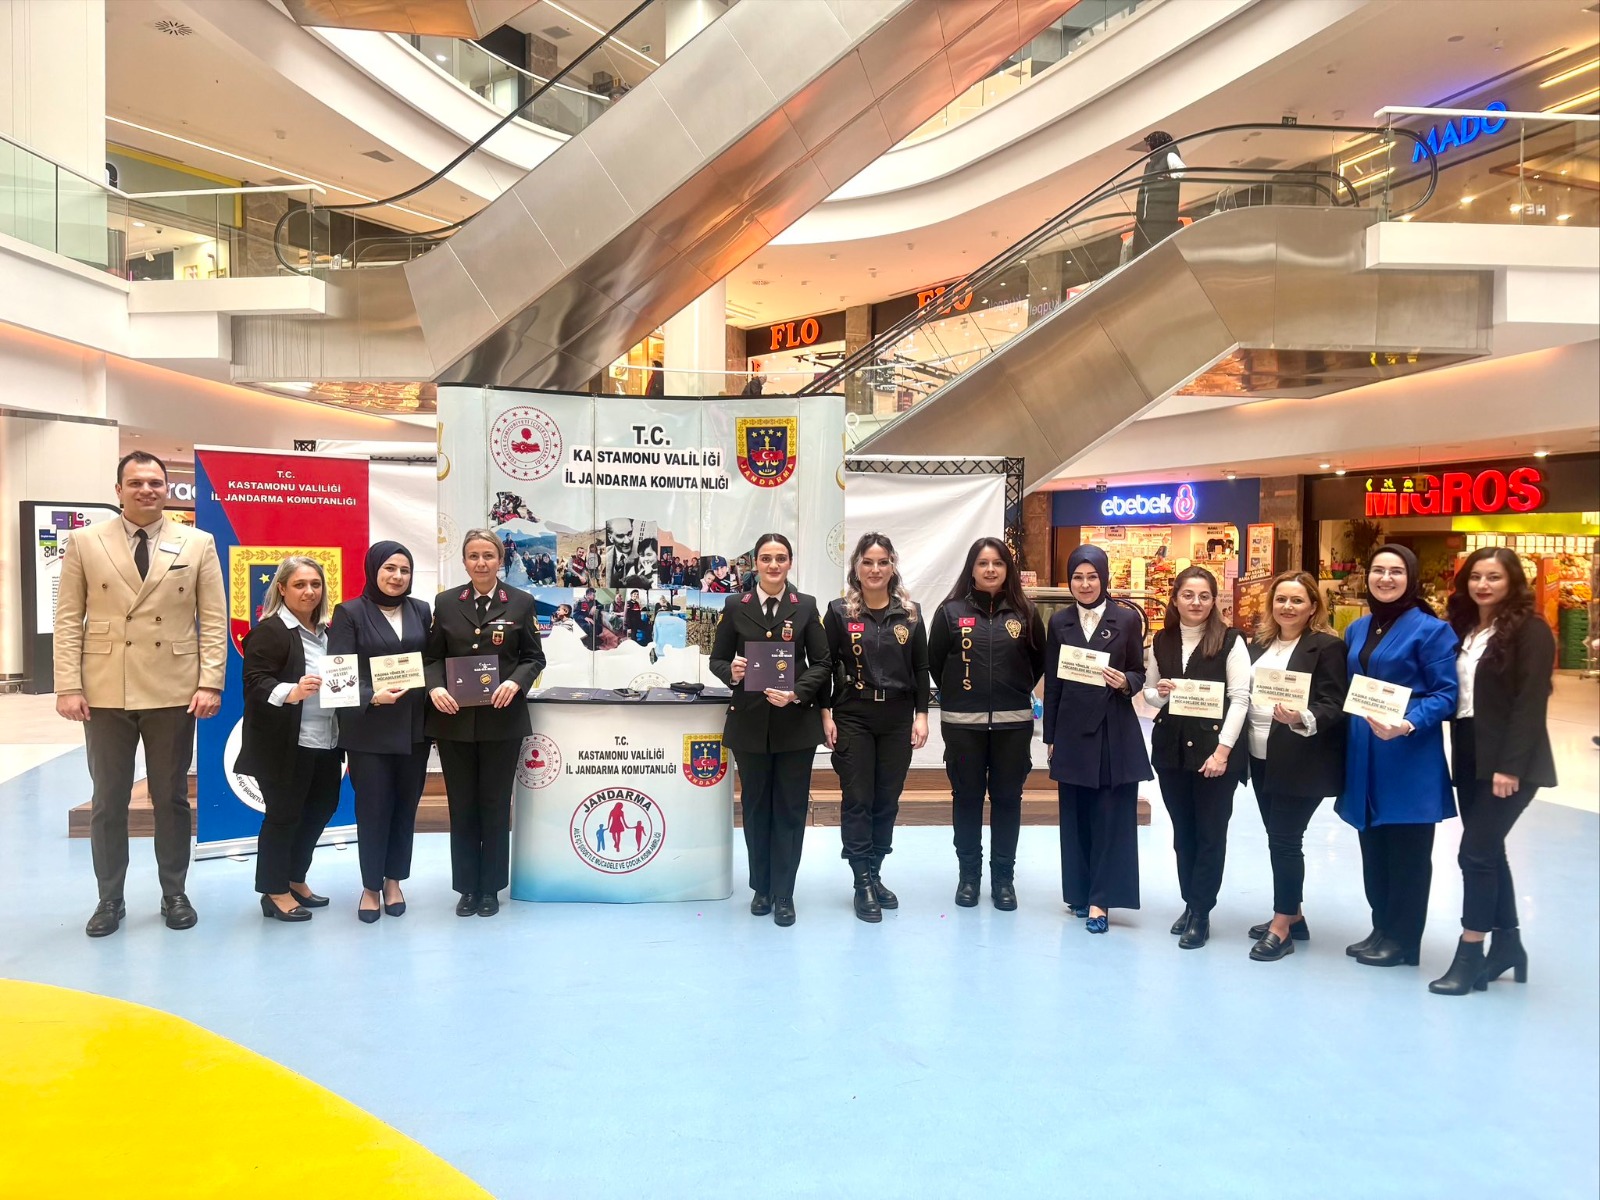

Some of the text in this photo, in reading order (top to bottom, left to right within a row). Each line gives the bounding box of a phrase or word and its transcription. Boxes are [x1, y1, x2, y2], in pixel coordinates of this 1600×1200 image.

[1412, 101, 1507, 163] MADO
[770, 318, 819, 350] FLO
[633, 426, 671, 446] T.C.
[573, 449, 721, 467] KASTAMONU VALİLİĞİ
[276, 471, 295, 479] T.C.
[565, 468, 729, 490] İL JANDARMA KOMUTANLIĞI
[740, 463, 794, 486] JANDARMA
[168, 481, 195, 501] ra
[228, 480, 342, 493] KASTAMONU VALİLİĞİ
[1365, 467, 1541, 517] MIGROS
[211, 491, 356, 506] İL JANDARMA KOMUTANLIĞI
[1101, 493, 1172, 516] ebebek
[1581, 511, 1599, 525] MI
[850, 632, 866, 690] POLİS
[961, 627, 973, 691] POLİS
[614, 736, 629, 746] T.C.
[578, 748, 665, 760] KASTAMONU VALİLİĞİ
[566, 763, 677, 775] İL JANDARMA KOMUTANLIĞI
[684, 768, 726, 786] JANDARMA
[583, 790, 652, 813] JANDARMA
